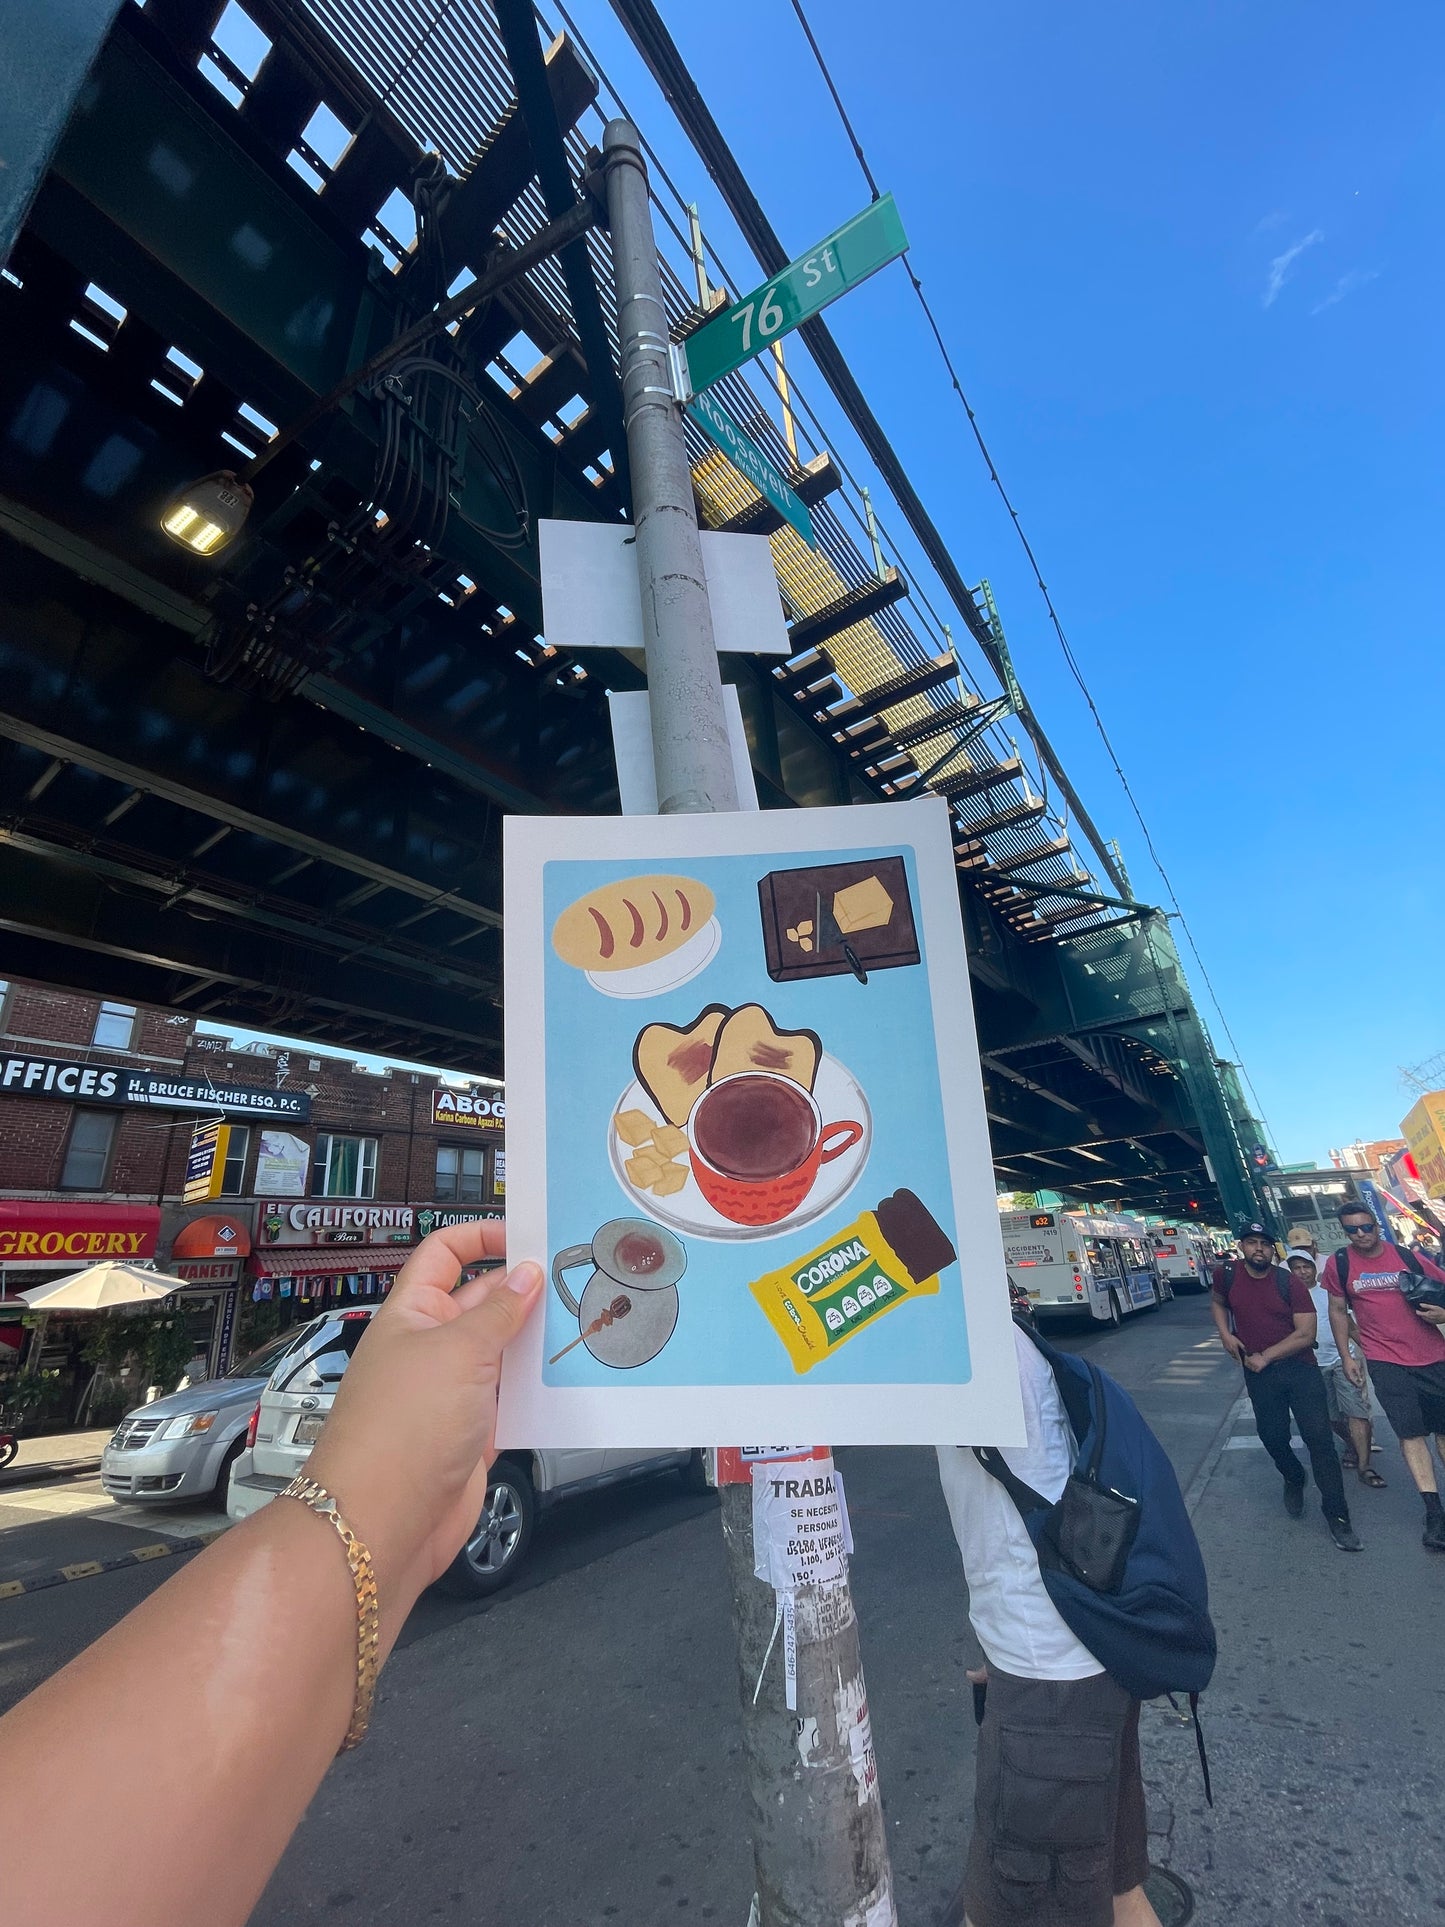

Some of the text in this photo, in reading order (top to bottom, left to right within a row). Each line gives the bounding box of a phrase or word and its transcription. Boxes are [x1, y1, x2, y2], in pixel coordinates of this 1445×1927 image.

[732, 248, 837, 351] 76 St
[700, 393, 792, 509] Roosevelt
[734, 452, 768, 495] Avenue
[0, 1060, 118, 1097] FFICES
[128, 1079, 301, 1111] H. BRUCE FISCHER ESQ. P.C.
[436, 1110, 454, 1122] Karina
[455, 1113, 477, 1125] Carbone
[267, 1203, 414, 1231] EL CALIFORNIA
[0, 1231, 147, 1255] GROCERY
[333, 1231, 358, 1242] Bar
[797, 1241, 871, 1294] CORONA
[827, 1279, 889, 1324] 25g 25g 25g 25g
[771, 1476, 835, 1498] TRABA
[790, 1509, 804, 1518] SE
[797, 1518, 838, 1533] PERSONAS
